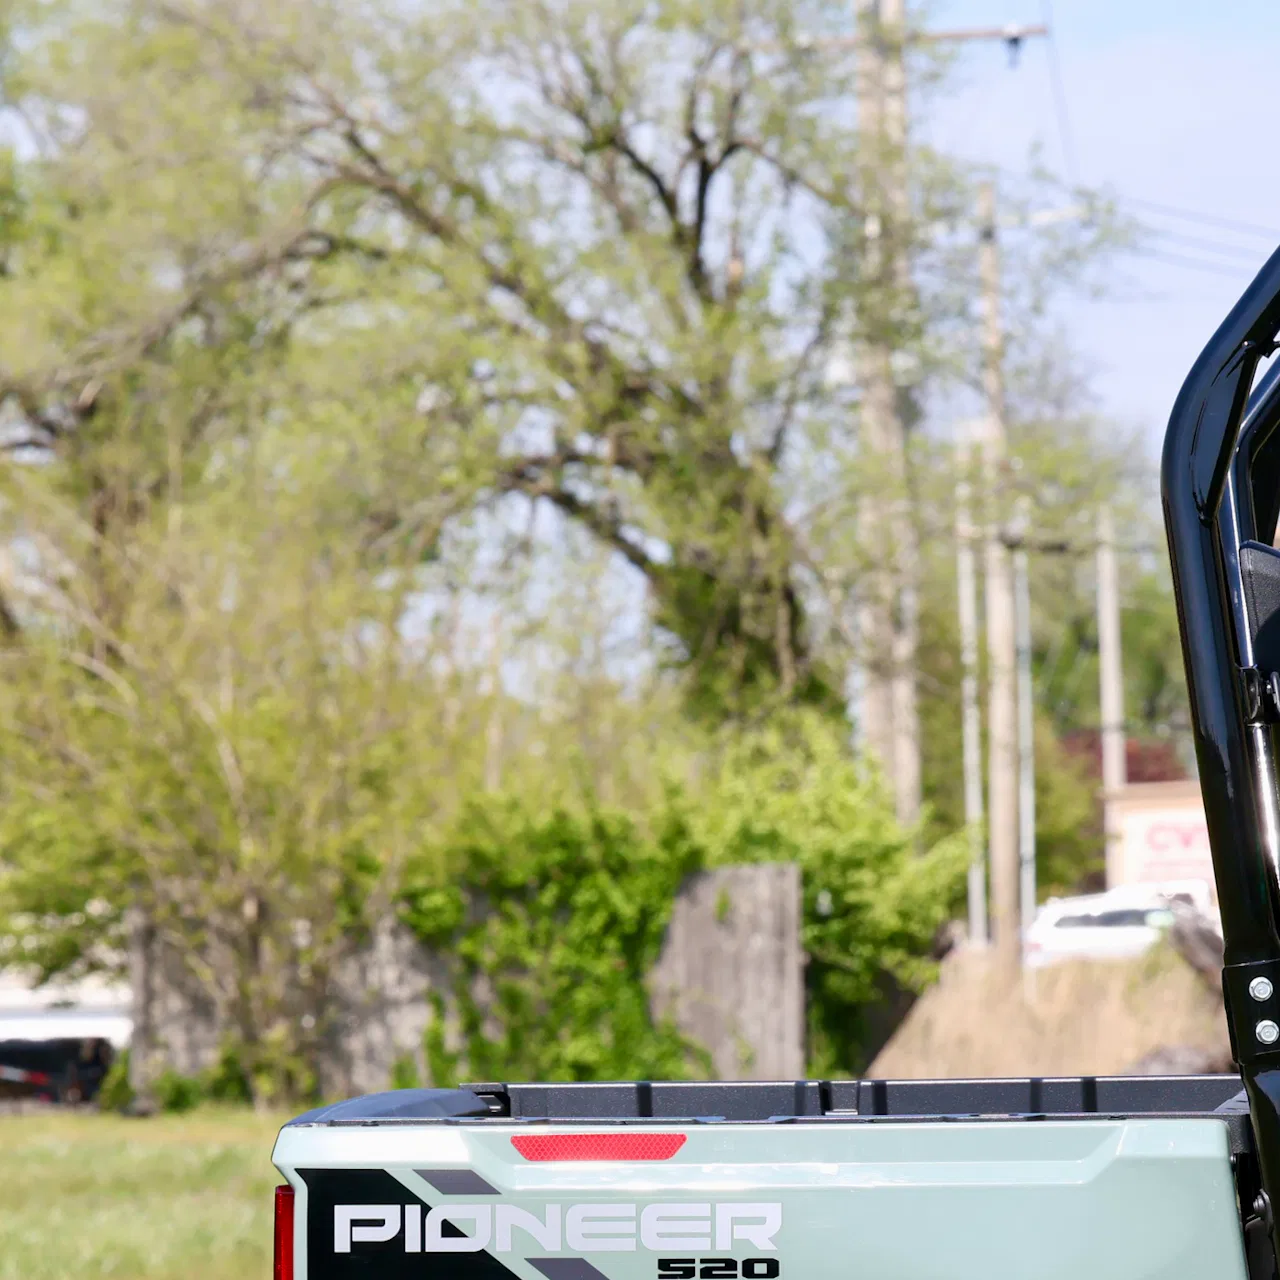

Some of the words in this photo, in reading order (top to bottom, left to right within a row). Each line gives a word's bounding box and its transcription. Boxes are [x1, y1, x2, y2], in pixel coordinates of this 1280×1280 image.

[1145, 823, 1209, 852] CV
[334, 1203, 782, 1252] PIONEER
[658, 1258, 780, 1279] 520
